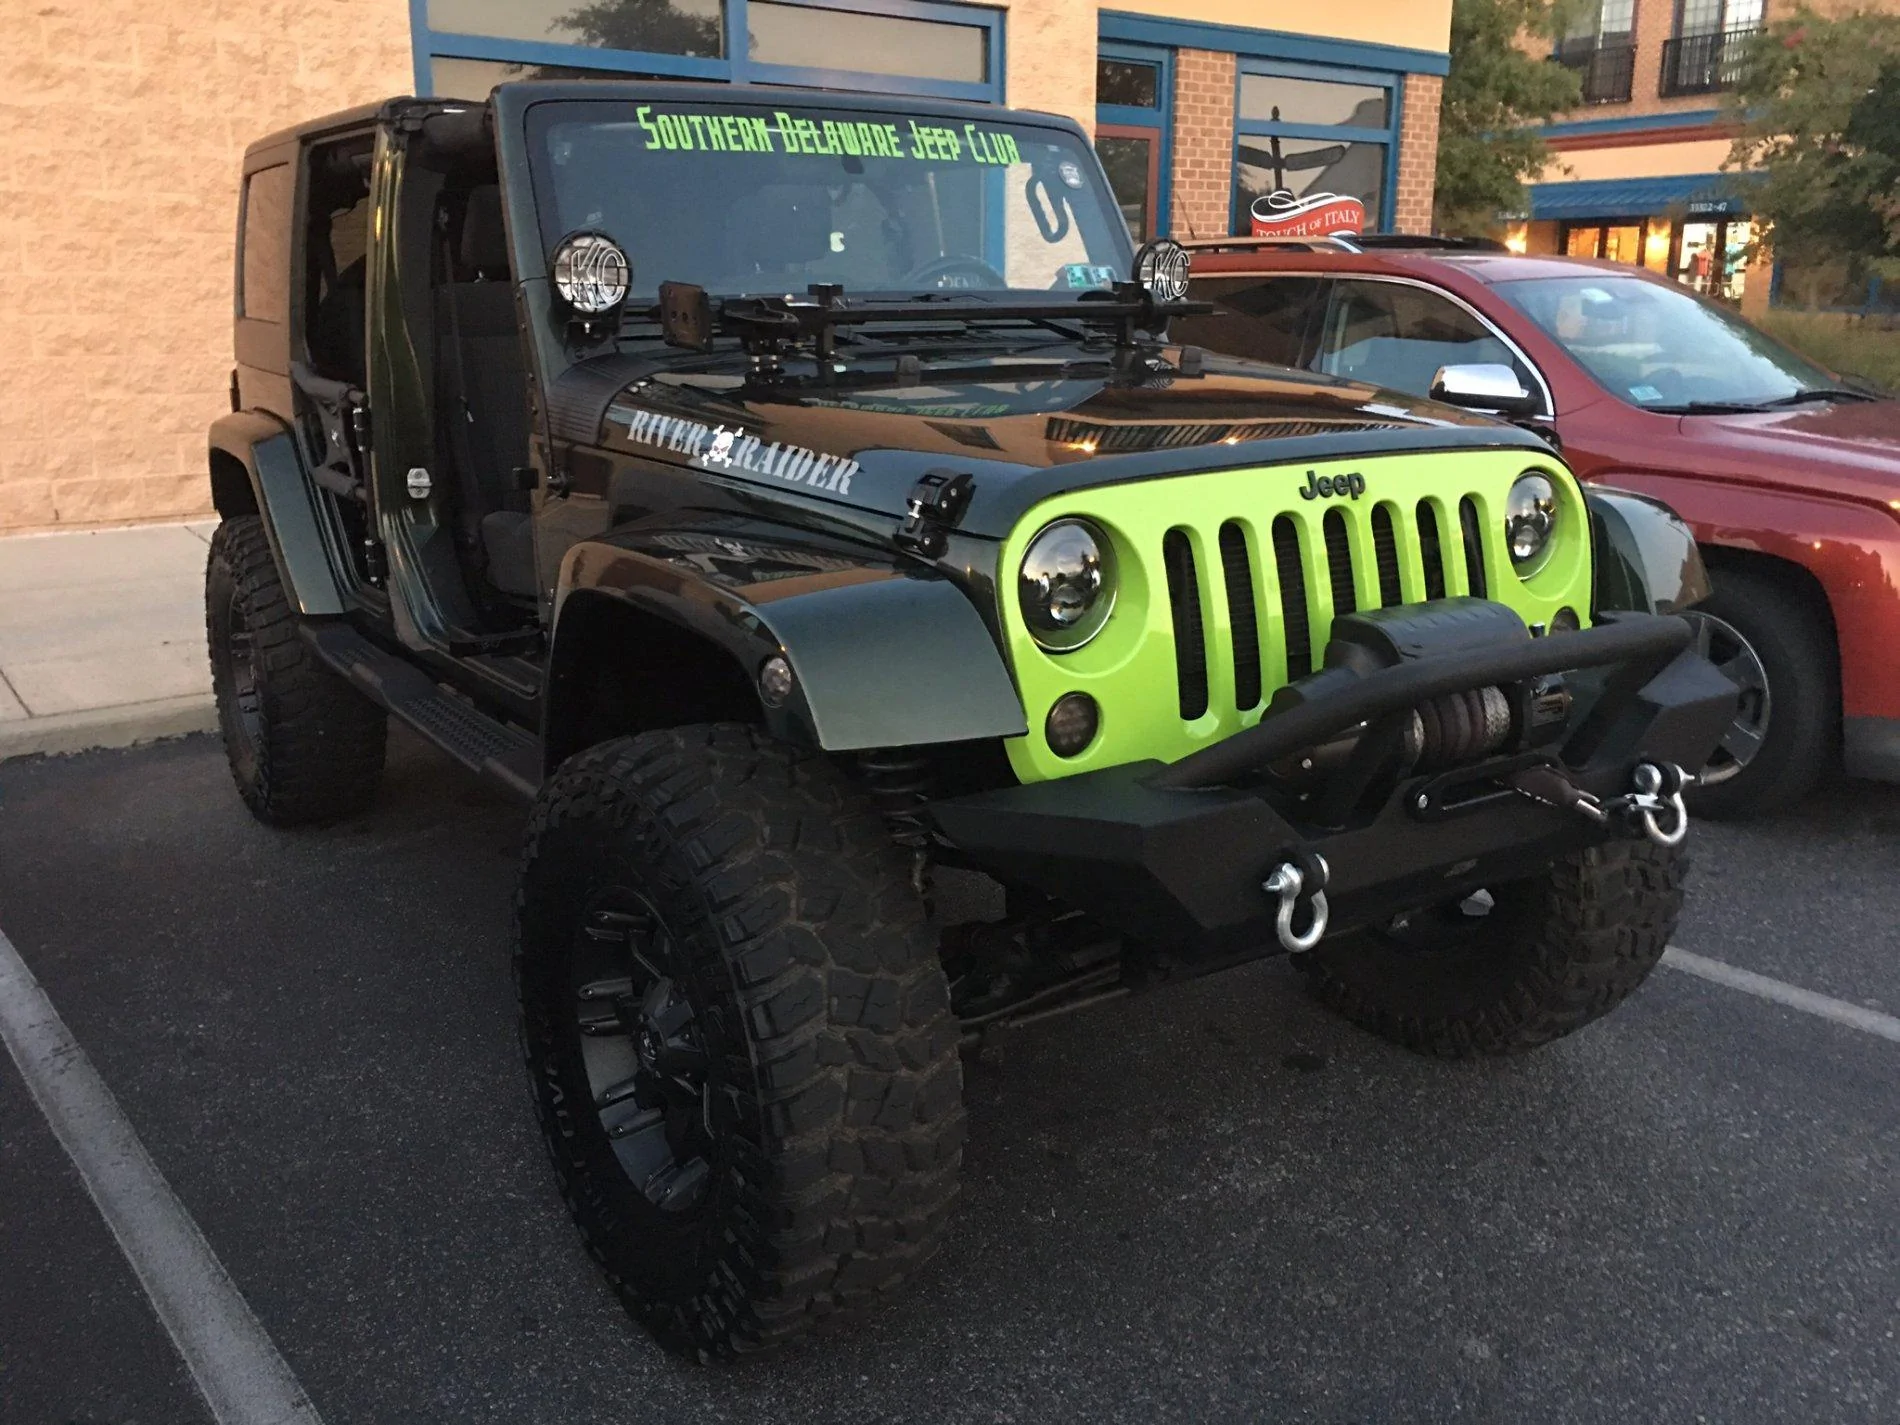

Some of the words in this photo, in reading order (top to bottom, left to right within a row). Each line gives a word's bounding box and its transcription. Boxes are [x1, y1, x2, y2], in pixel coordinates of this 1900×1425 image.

[1324, 209, 1360, 227] ITALY
[571, 242, 626, 308] KC
[1154, 246, 1191, 300] KC
[627, 410, 708, 457] RIVER
[732, 435, 860, 495] RAIDER
[1299, 470, 1366, 500] Jeep
